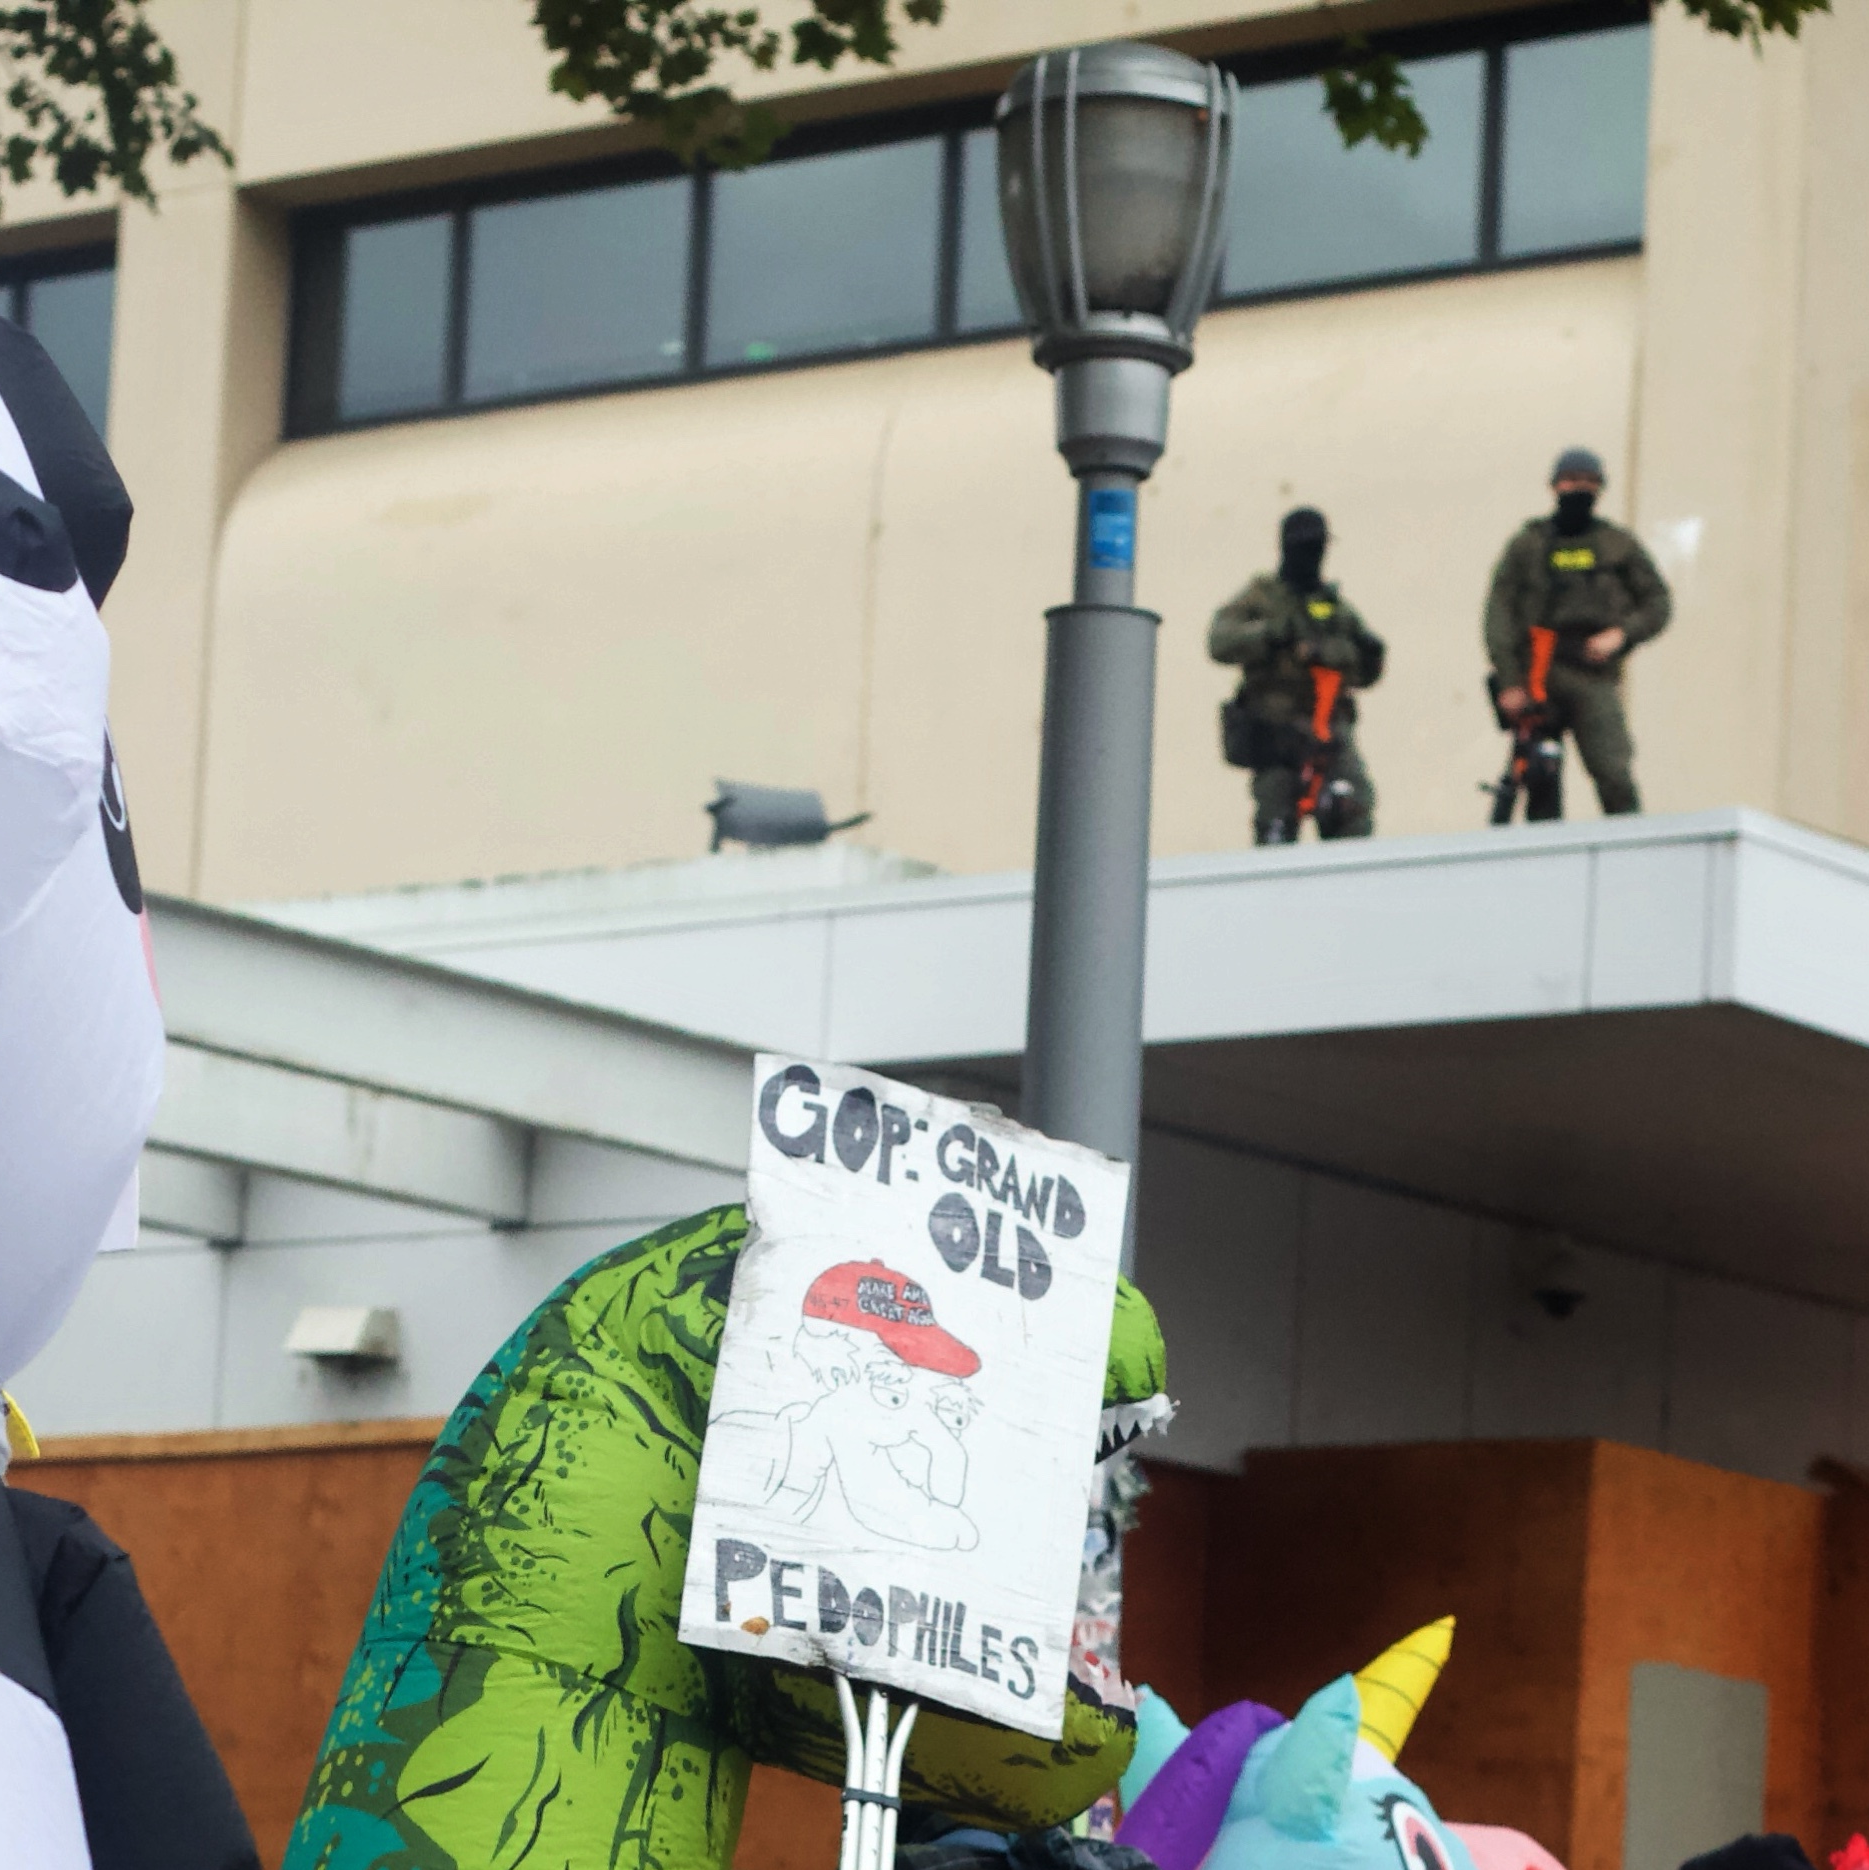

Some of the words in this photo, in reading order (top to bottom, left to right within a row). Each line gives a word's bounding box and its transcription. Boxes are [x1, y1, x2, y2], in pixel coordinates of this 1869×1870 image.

[758, 1064, 928, 1186] GOP:
[936, 1123, 1086, 1240] GRAND
[857, 1279, 896, 1300] MAKE
[927, 1192, 1053, 1301] OLD
[714, 1537, 1040, 1701] PEDOPHILES
